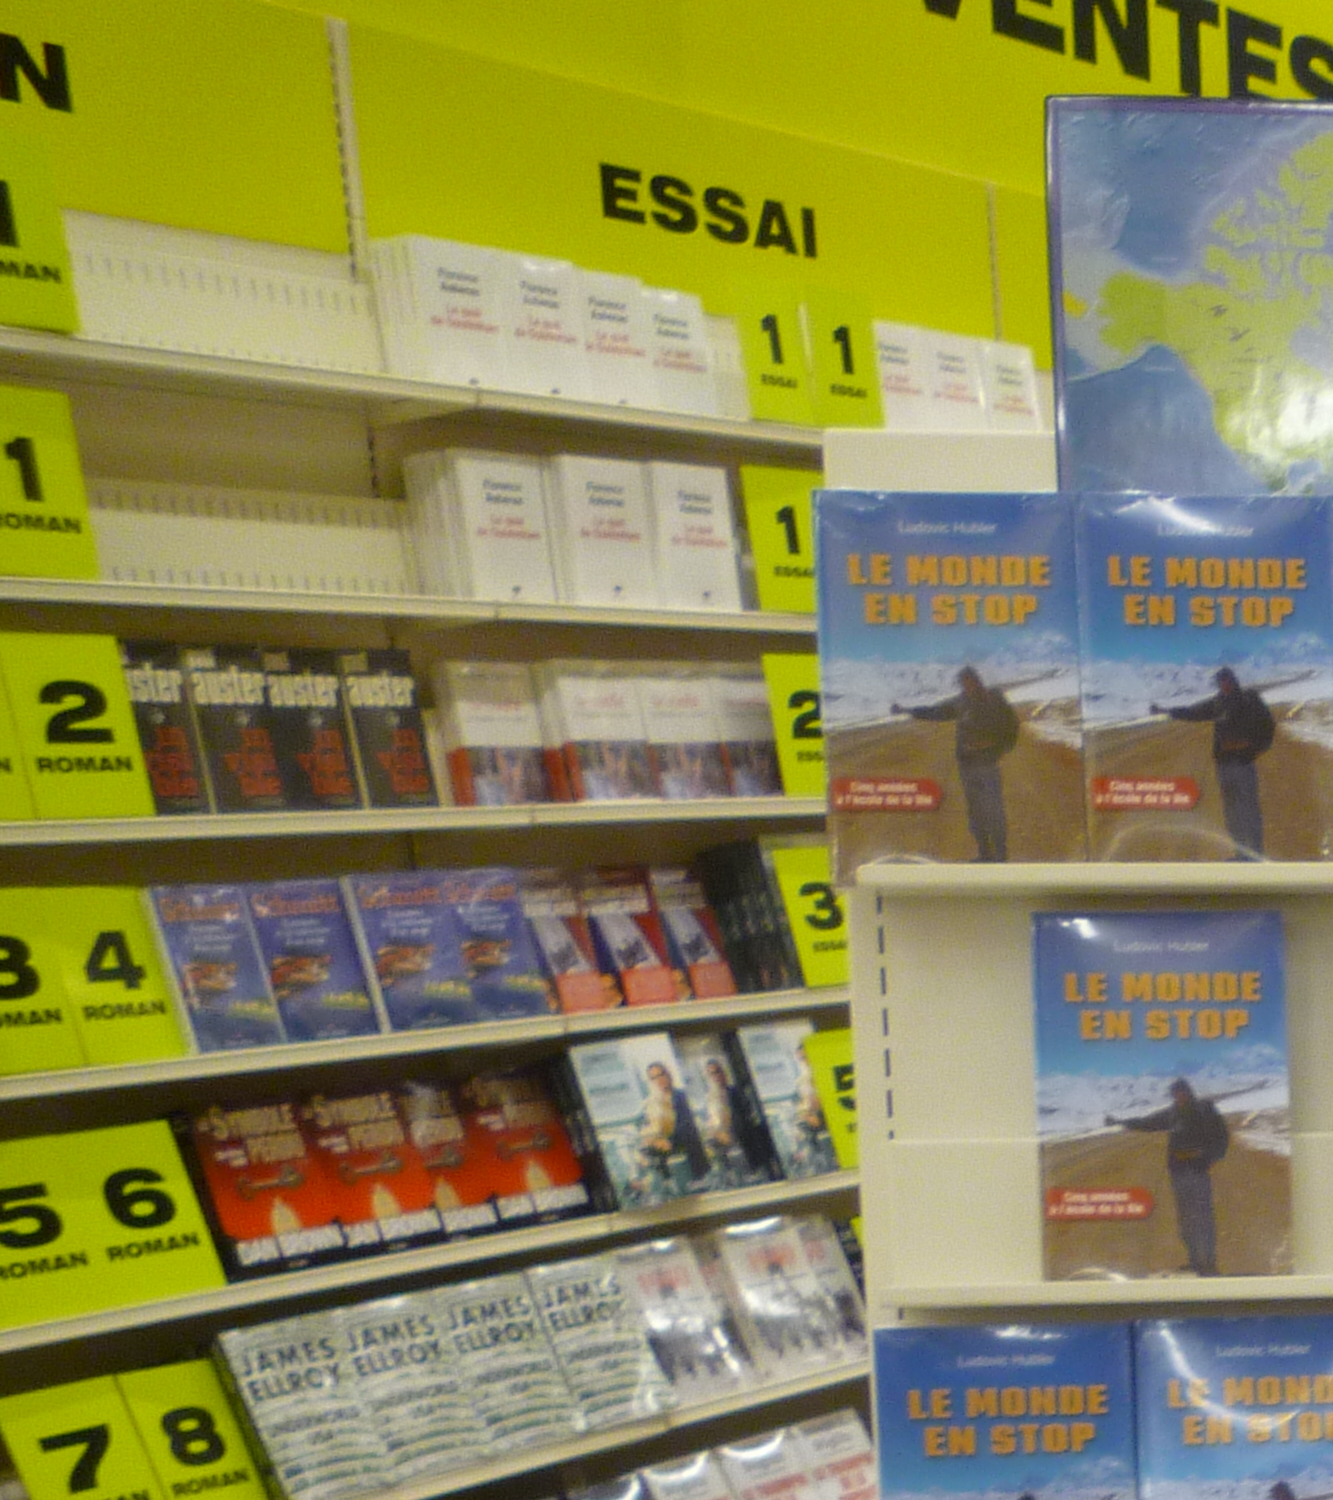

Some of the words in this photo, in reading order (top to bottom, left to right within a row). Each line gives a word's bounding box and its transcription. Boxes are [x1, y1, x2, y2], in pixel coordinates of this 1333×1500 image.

[600, 163, 818, 258] ESSAI
[762, 315, 783, 364] 1
[834, 327, 853, 374] 1
[4, 437, 42, 501] 1
[777, 507, 800, 554] 1
[848, 555, 889, 584] LE
[907, 556, 1047, 585] MONDE
[866, 594, 916, 622] EN
[933, 594, 1036, 624] STOP
[39, 680, 113, 743] 2
[36, 757, 132, 773] ROMAN
[803, 881, 842, 931] 3
[85, 931, 146, 989] 4
[1066, 974, 1105, 1001] LE
[1123, 973, 1258, 1001] MONDE
[82, 1000, 168, 1021] ROMAN
[1082, 1011, 1130, 1038] EN
[1146, 1009, 1248, 1039] STOP
[0, 1185, 62, 1249] 5
[103, 1168, 175, 1229] 6
[106, 1233, 199, 1261] ROMAN
[543, 1276, 621, 1308] JAMES
[448, 1295, 534, 1331] JAMES
[347, 1314, 436, 1352] JAMES
[454, 1320, 536, 1353] ELLROY
[242, 1338, 336, 1377] JAMES
[355, 1338, 441, 1376] ELLROY
[247, 1362, 340, 1402] ELLROY
[909, 1389, 950, 1419] LE
[967, 1385, 1106, 1417] MONDE
[161, 1406, 226, 1466] 8
[925, 1427, 975, 1455] EN
[991, 1423, 1094, 1454] STOP
[39, 1424, 109, 1493] 7
[172, 1467, 251, 1496] ROMAN
